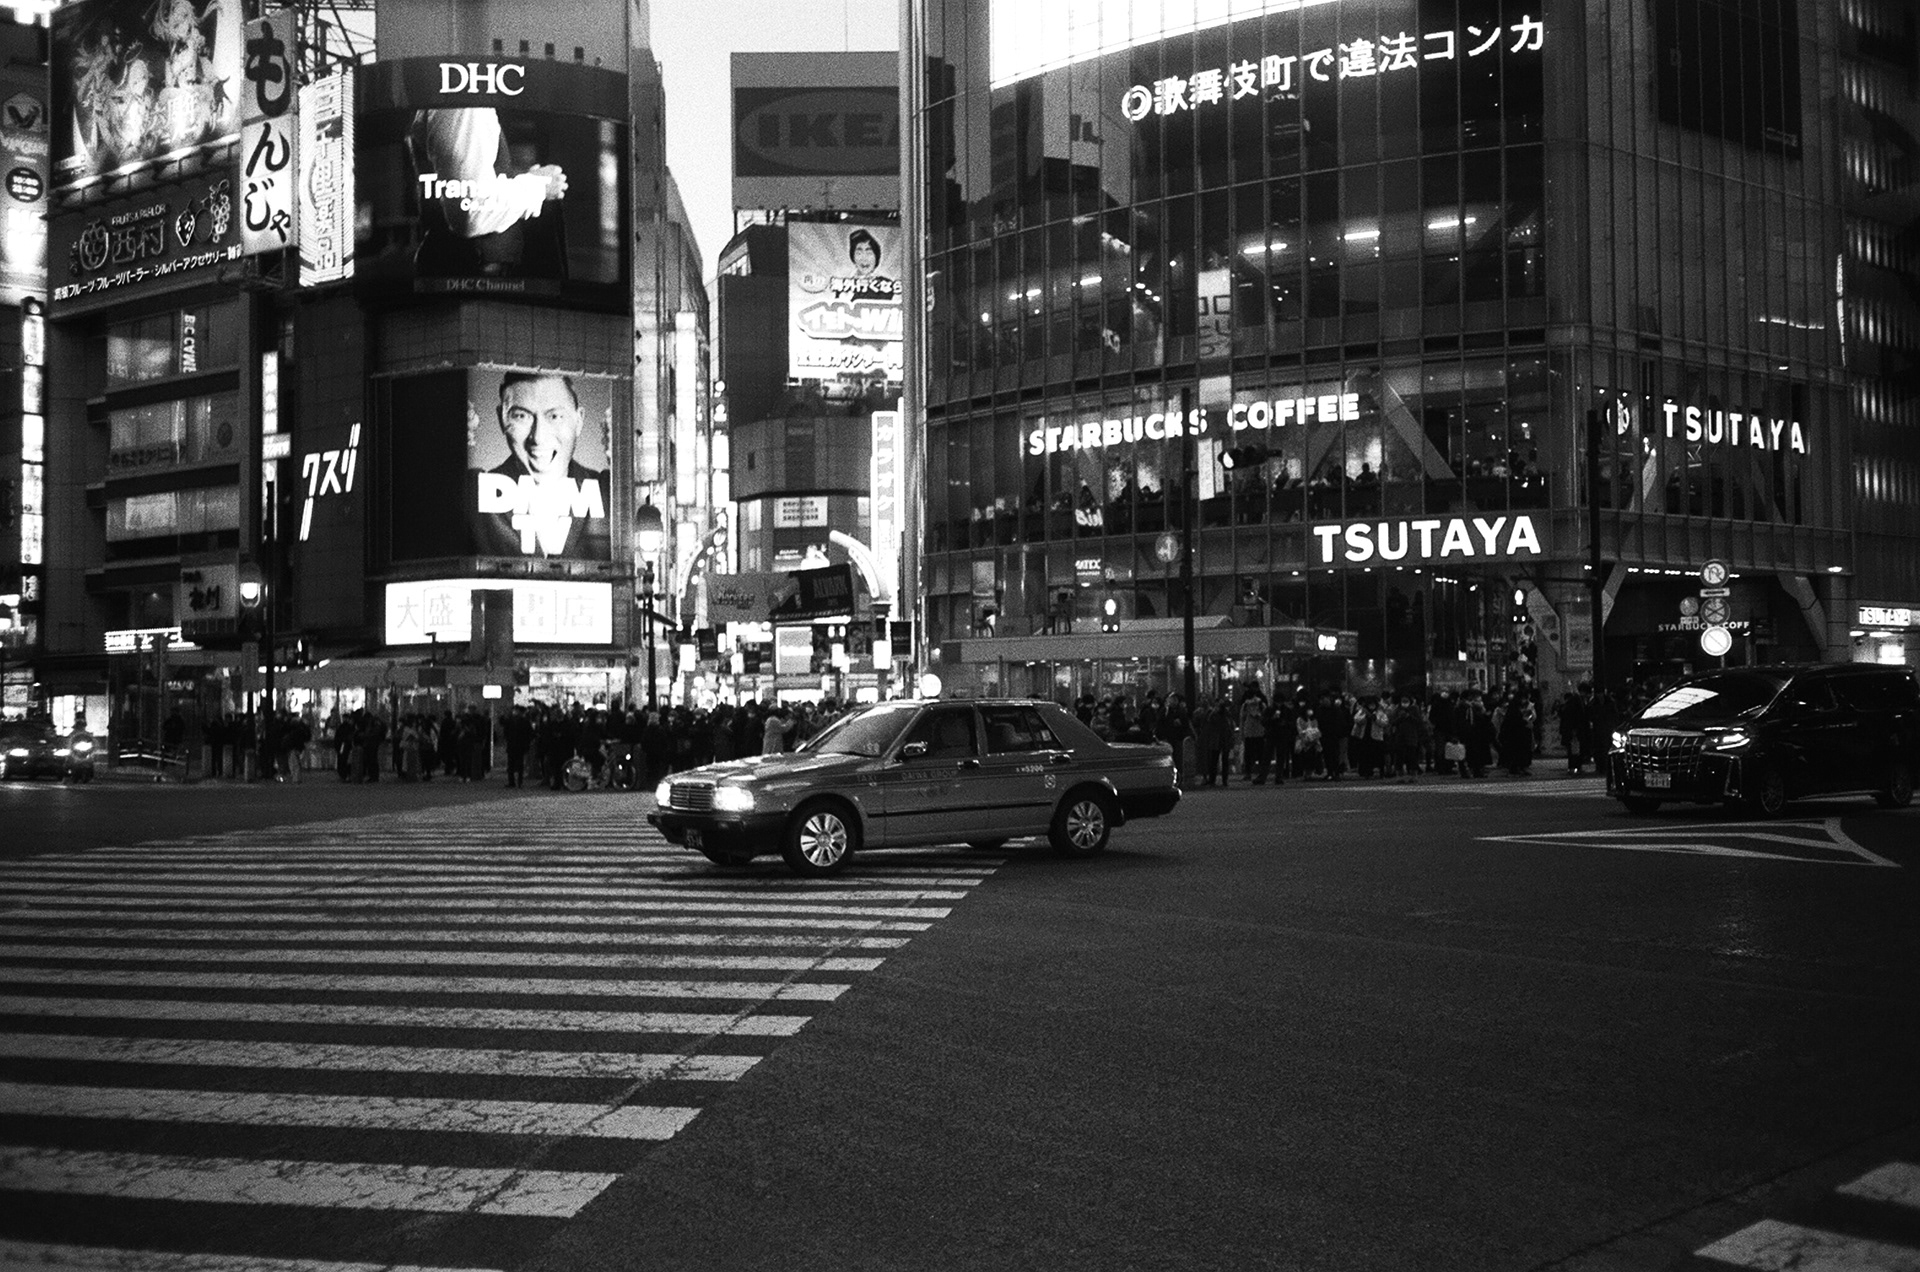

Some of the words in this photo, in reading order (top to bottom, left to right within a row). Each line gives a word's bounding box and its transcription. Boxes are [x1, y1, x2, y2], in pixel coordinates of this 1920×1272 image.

[439, 62, 525, 96] DHC
[1029, 408, 1208, 456] STARBUCKS
[1226, 393, 1360, 431] COFFEE
[1663, 402, 1806, 455] TSUTAYA
[511, 515, 573, 555] TV
[1313, 515, 1542, 563] TSUTAYA
[1858, 608, 1910, 624] TSUTAYA
